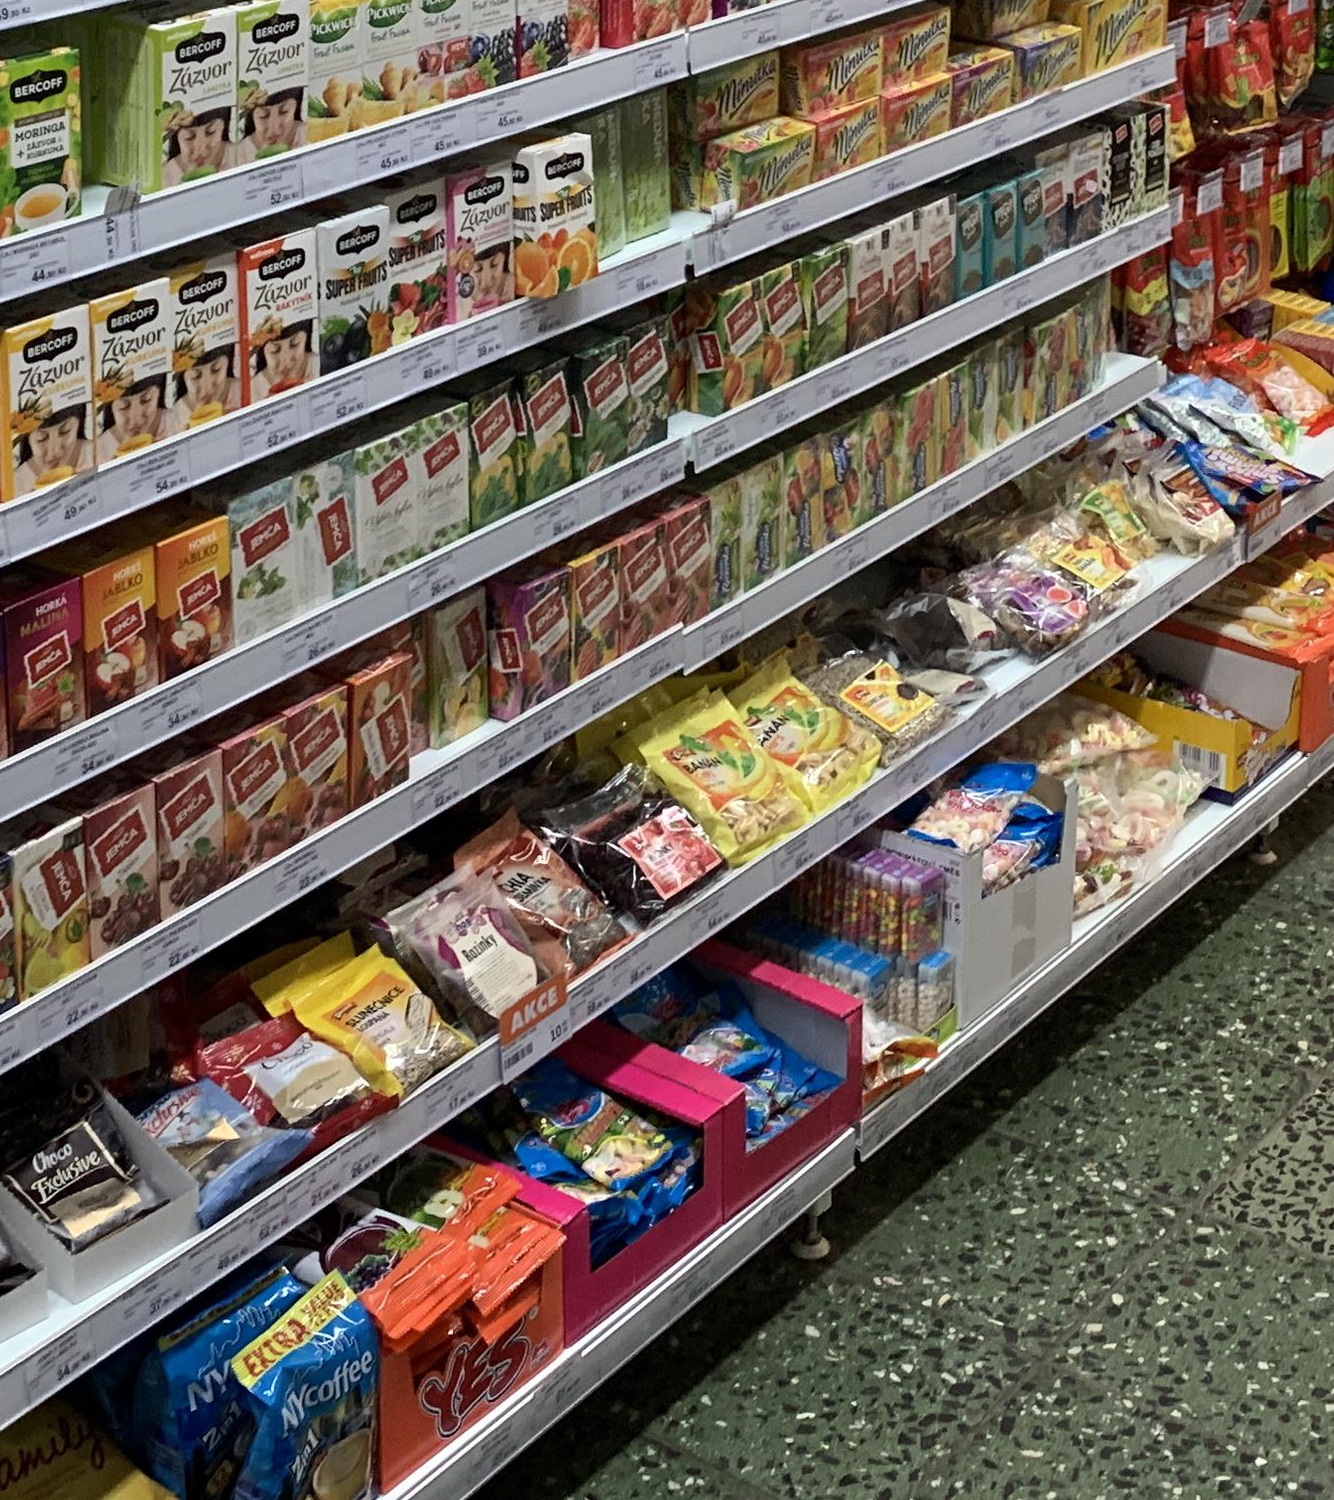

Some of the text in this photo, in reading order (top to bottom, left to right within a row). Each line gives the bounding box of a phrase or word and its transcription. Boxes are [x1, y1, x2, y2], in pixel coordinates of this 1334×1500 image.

[15, 121, 66, 142] MORINGA
[460, 202, 511, 231] Zázvor
[540, 202, 565, 222] SUPER
[262, 254, 302, 274] BERCOFF
[182, 277, 224, 300] BERCOFF
[326, 262, 387, 299] SUPER FRUITS
[110, 304, 155, 328] BERCOFF
[26, 334, 74, 358] BERCOFF
[178, 543, 219, 568] JABLKO
[103, 573, 143, 599] JABLKO
[20, 607, 68, 638] MALINA
[463, 930, 501, 964] Rozinky
[33, 1143, 73, 1174] Choco
[243, 1318, 313, 1379] EXTRA
[281, 1350, 374, 1434] NYcoffee
[420, 1323, 530, 1438] YES
